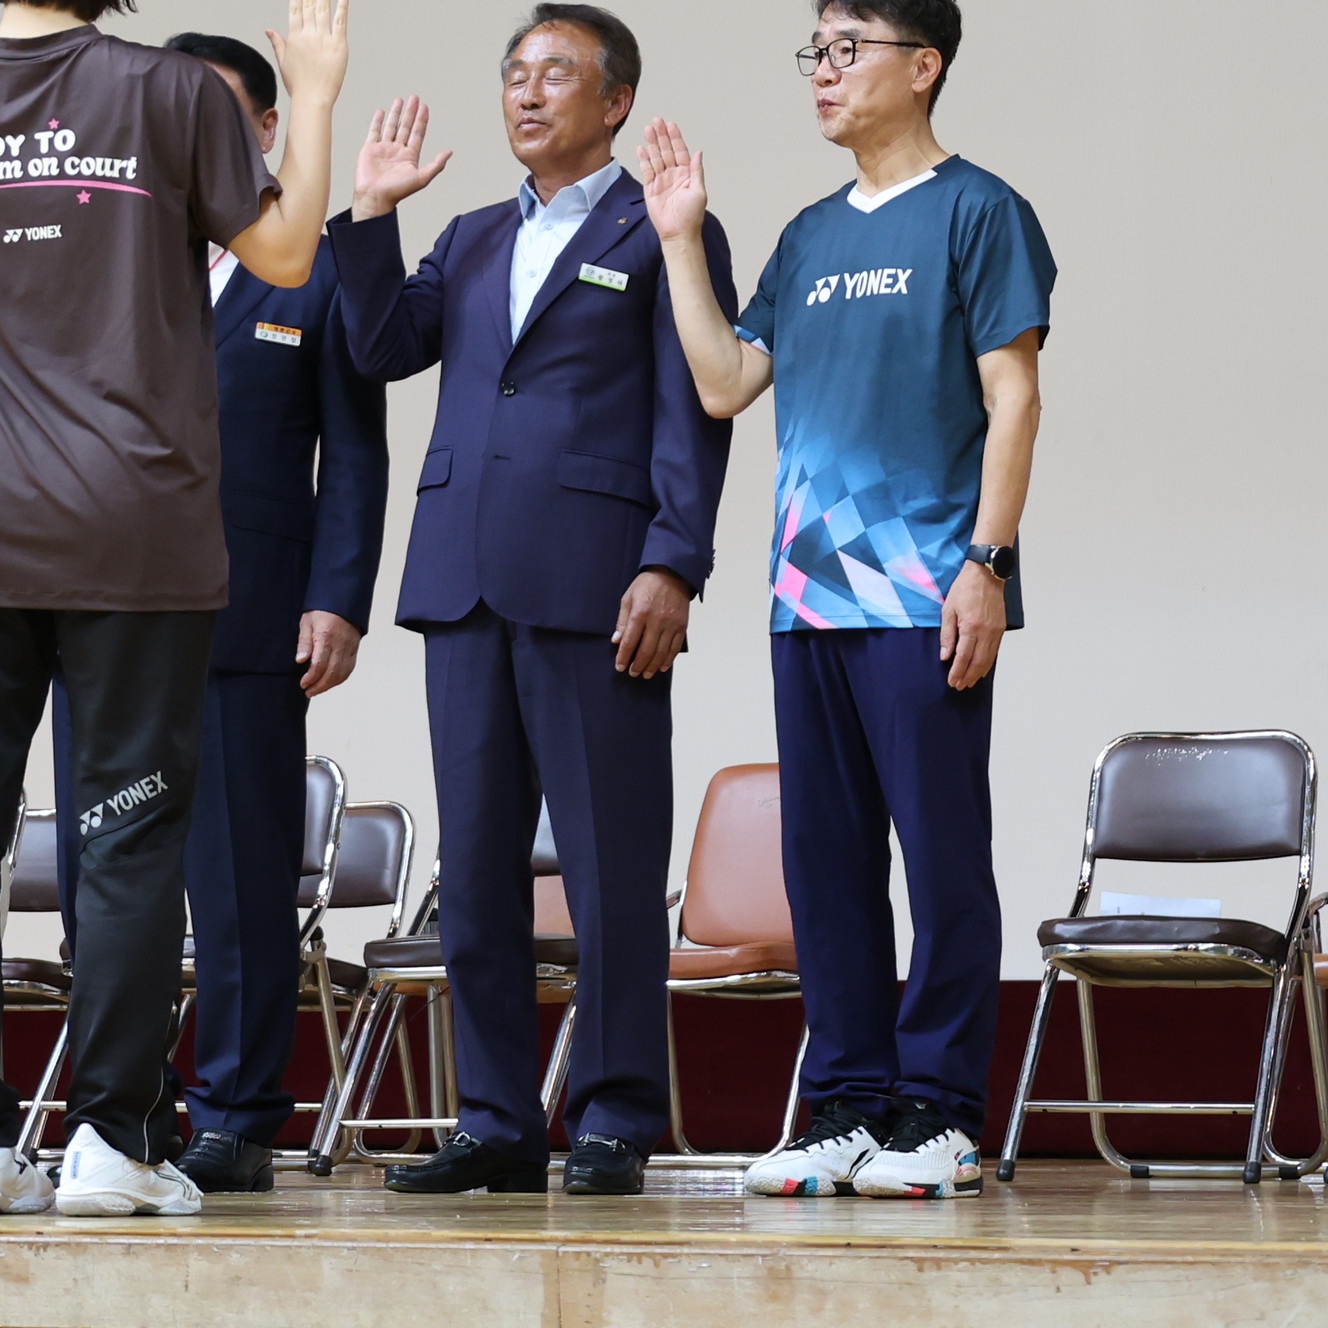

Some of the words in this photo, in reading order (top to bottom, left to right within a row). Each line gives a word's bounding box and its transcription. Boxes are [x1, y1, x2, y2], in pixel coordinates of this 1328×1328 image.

[34, 129, 76, 154] TO
[27, 157, 60, 177] on
[64, 156, 138, 180] court
[25, 224, 62, 241] YONEX
[843, 268, 913, 300] YONEX
[106, 770, 168, 816] YONEX
